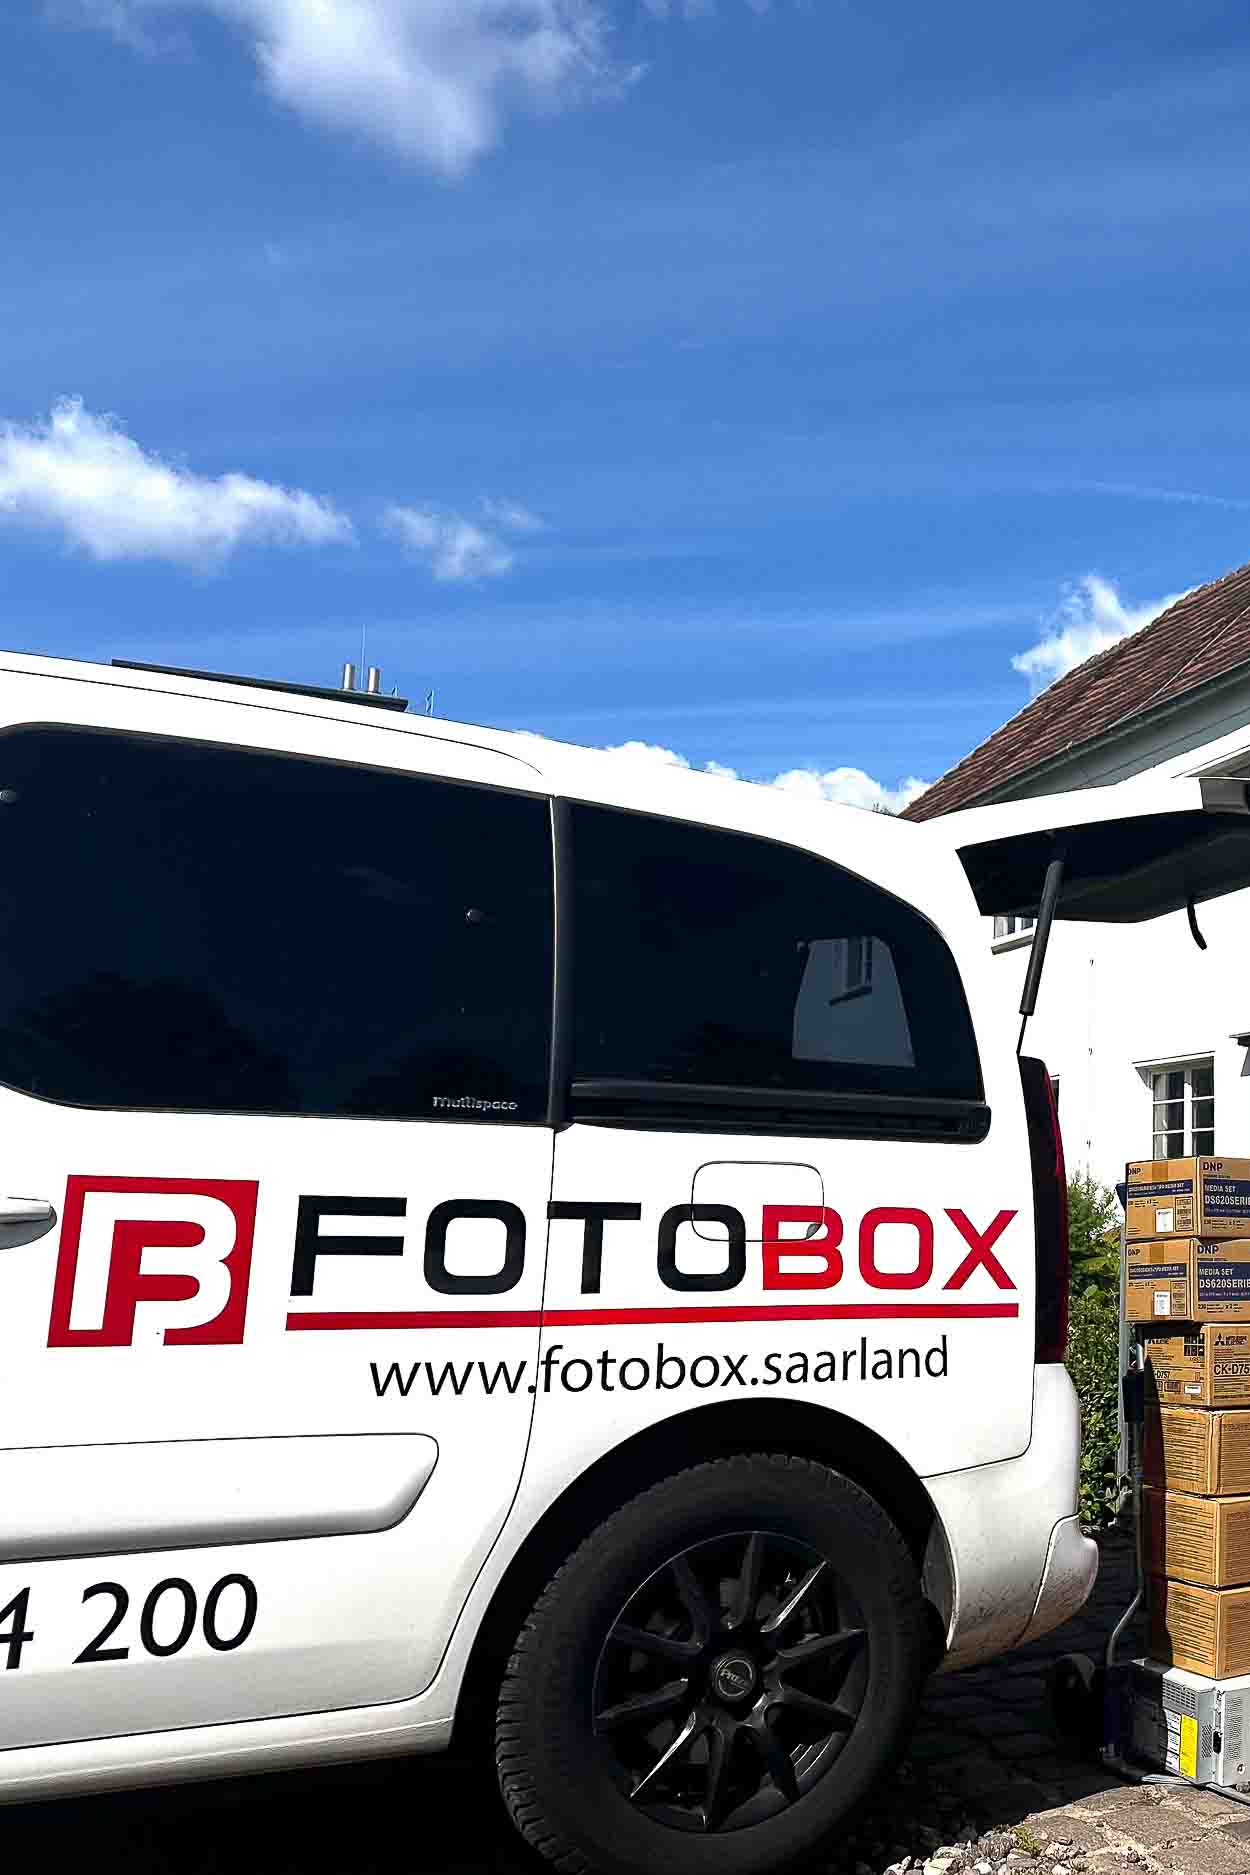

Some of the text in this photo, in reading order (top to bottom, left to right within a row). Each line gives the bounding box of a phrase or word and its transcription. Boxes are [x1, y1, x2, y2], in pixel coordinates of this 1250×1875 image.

[1202, 1161, 1223, 1172] DNP
[1204, 1184, 1236, 1193] MEDIA SET
[290, 1195, 1018, 1296] FOTOBOX
[1197, 1244, 1219, 1254] DNP
[369, 1335, 949, 1397] www.fotobox.saarland
[72, 1573, 258, 1664] 200
